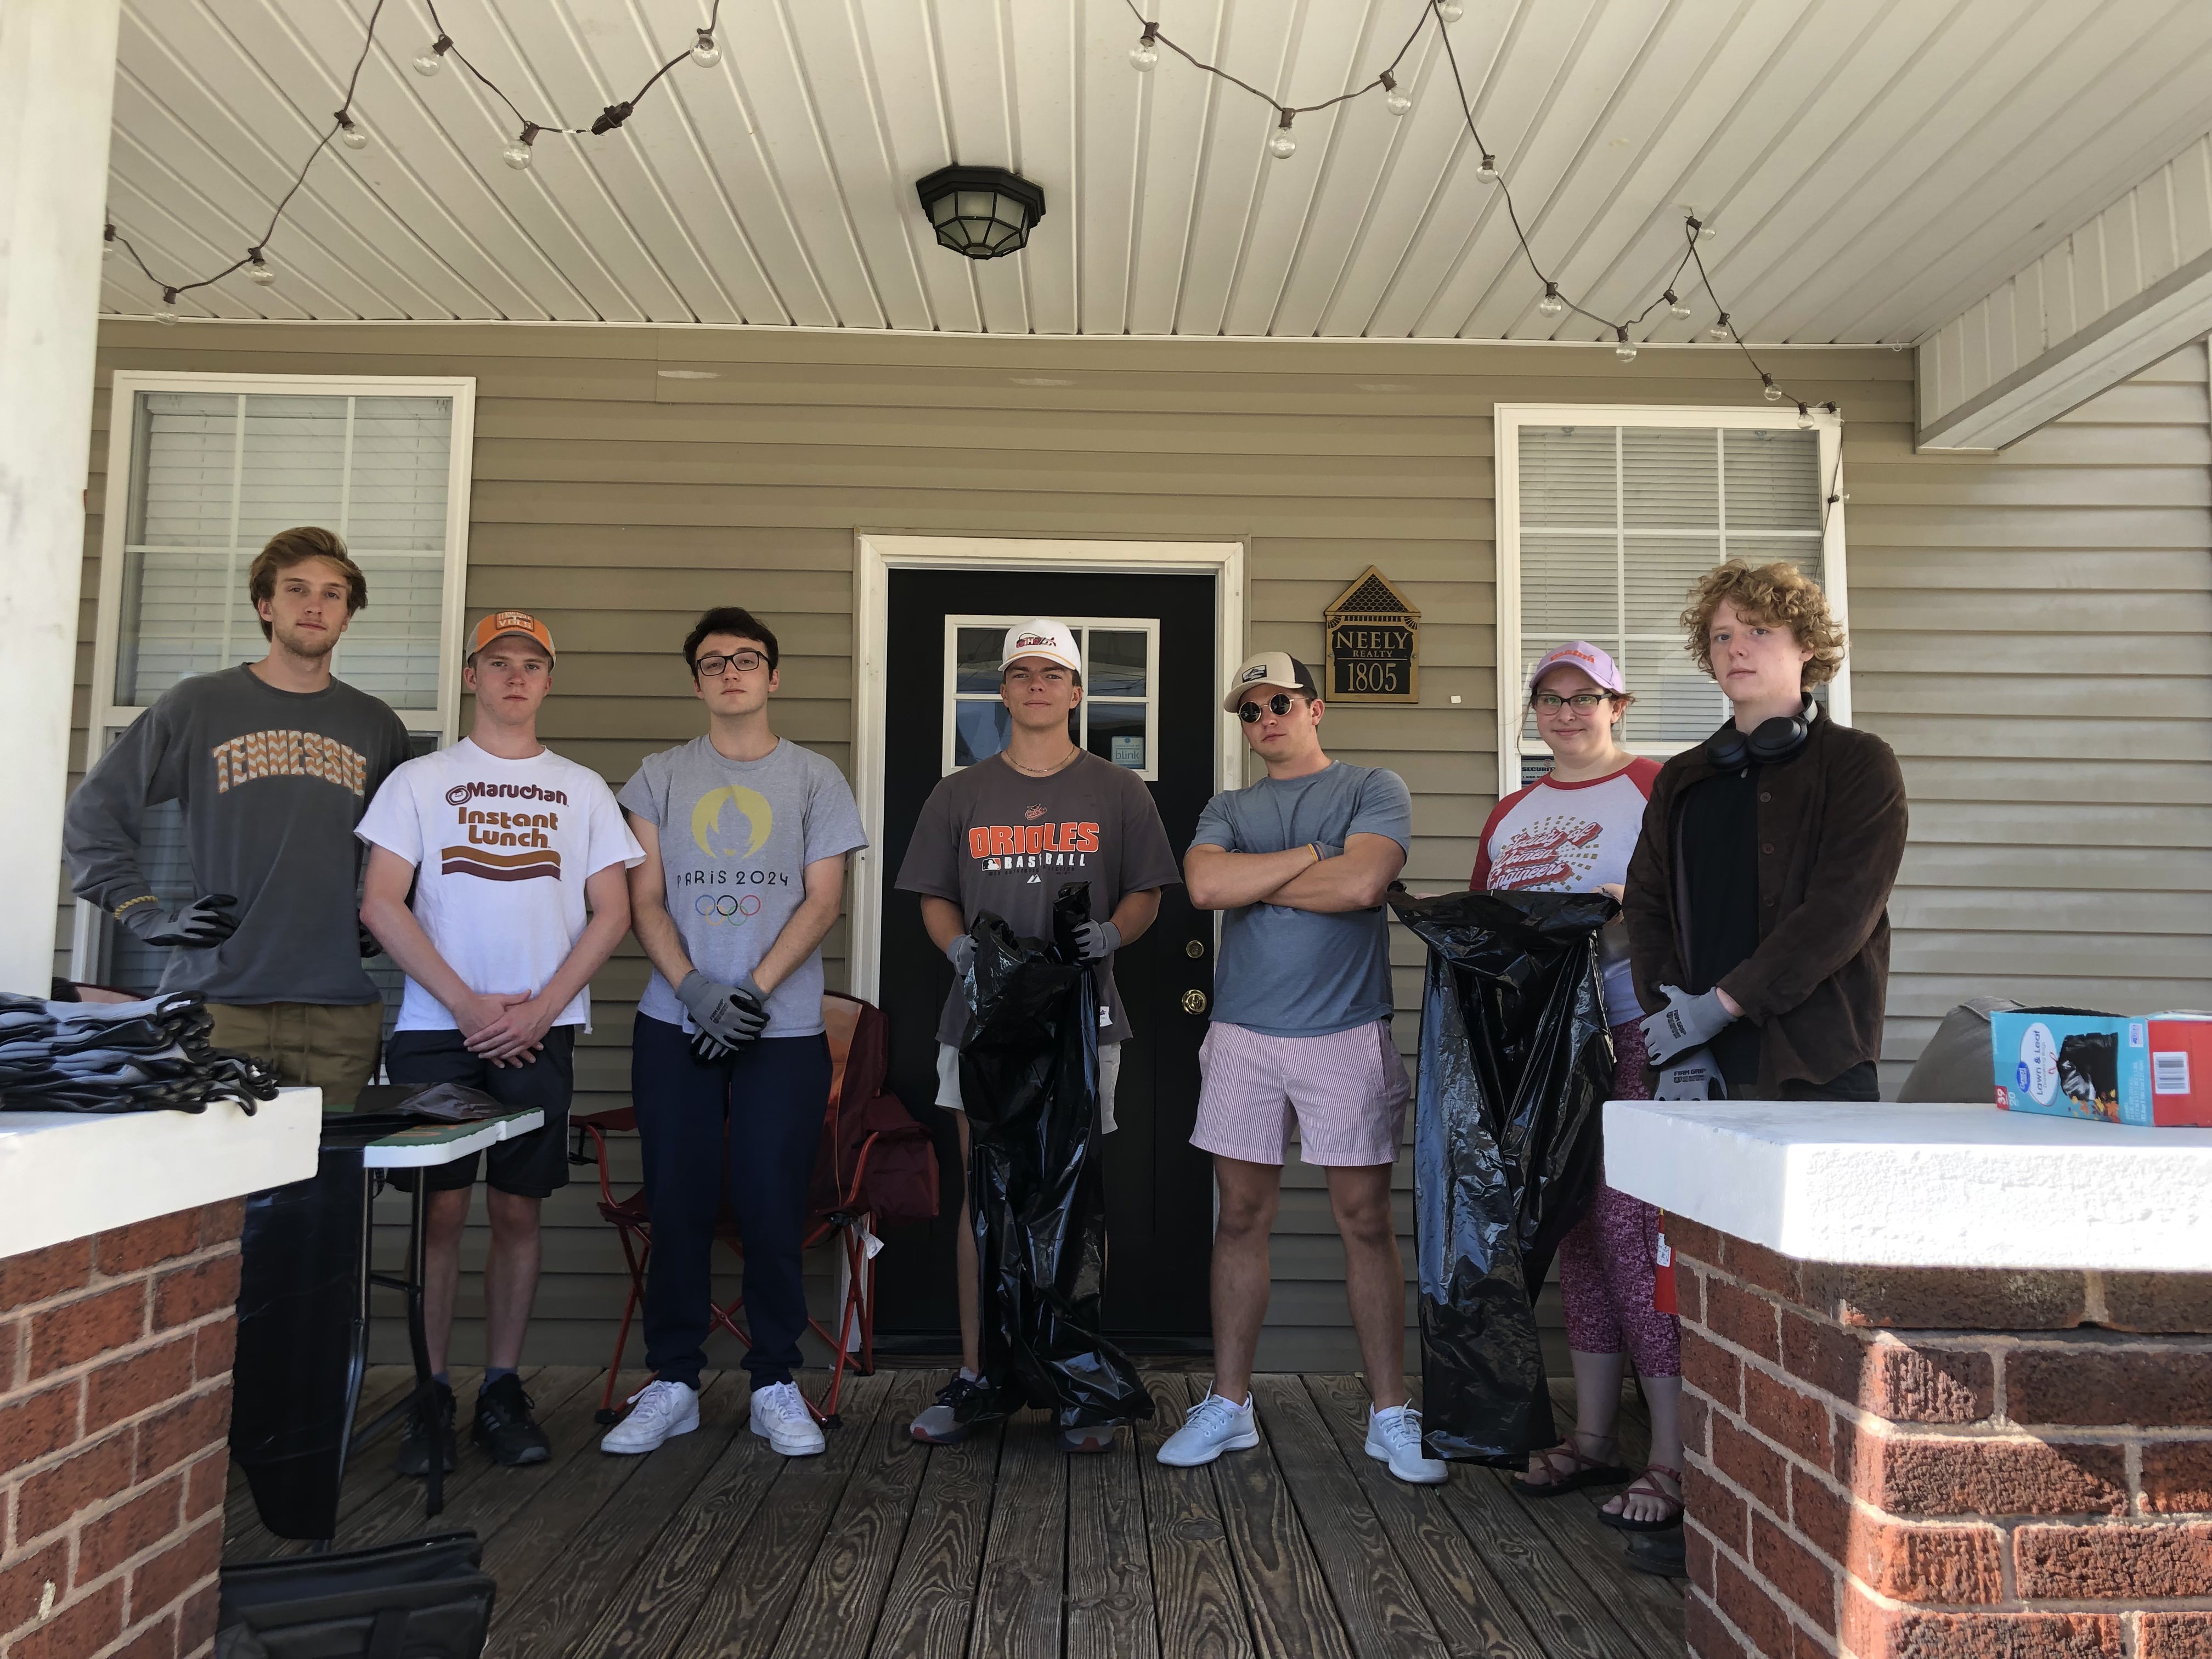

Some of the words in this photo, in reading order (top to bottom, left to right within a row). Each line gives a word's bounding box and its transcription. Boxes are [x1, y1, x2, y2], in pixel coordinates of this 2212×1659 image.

[1335, 631, 1410, 650] NEELY
[1347, 662, 1397, 691] 1805
[212, 729, 366, 797] TENNESSEE
[1115, 750, 1139, 759] blink
[467, 782, 568, 805] Maruchan
[459, 807, 558, 831] Instant
[469, 825, 549, 848] Lunch
[969, 822, 1099, 859] ORIOLES
[736, 870, 788, 886] 2024
[1677, 1021, 1686, 1035] GRIP
[1997, 1088, 2006, 1105] 39
[2008, 1092, 2016, 1107] 20
